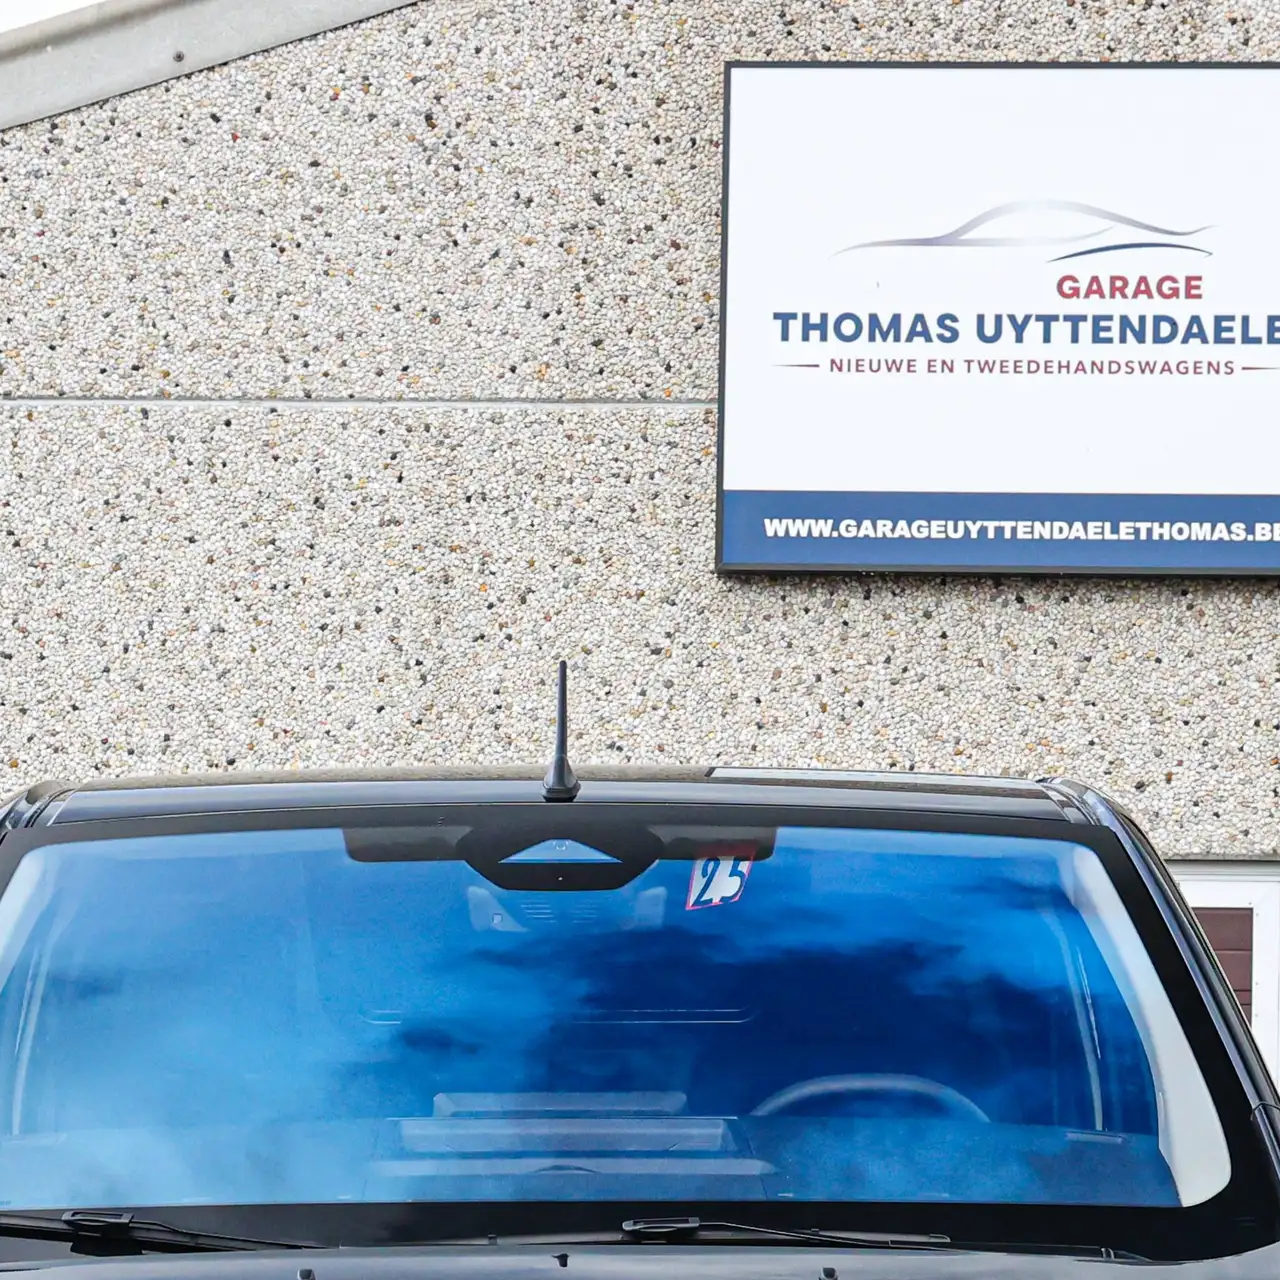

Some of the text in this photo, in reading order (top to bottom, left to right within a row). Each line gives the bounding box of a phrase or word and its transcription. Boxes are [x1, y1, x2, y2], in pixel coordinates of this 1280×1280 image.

[1056, 274, 1203, 300] GARAGE
[772, 311, 960, 344] THOMAS
[829, 357, 1235, 376] NIEUWE EN TWEEDEHANDSWAGENS
